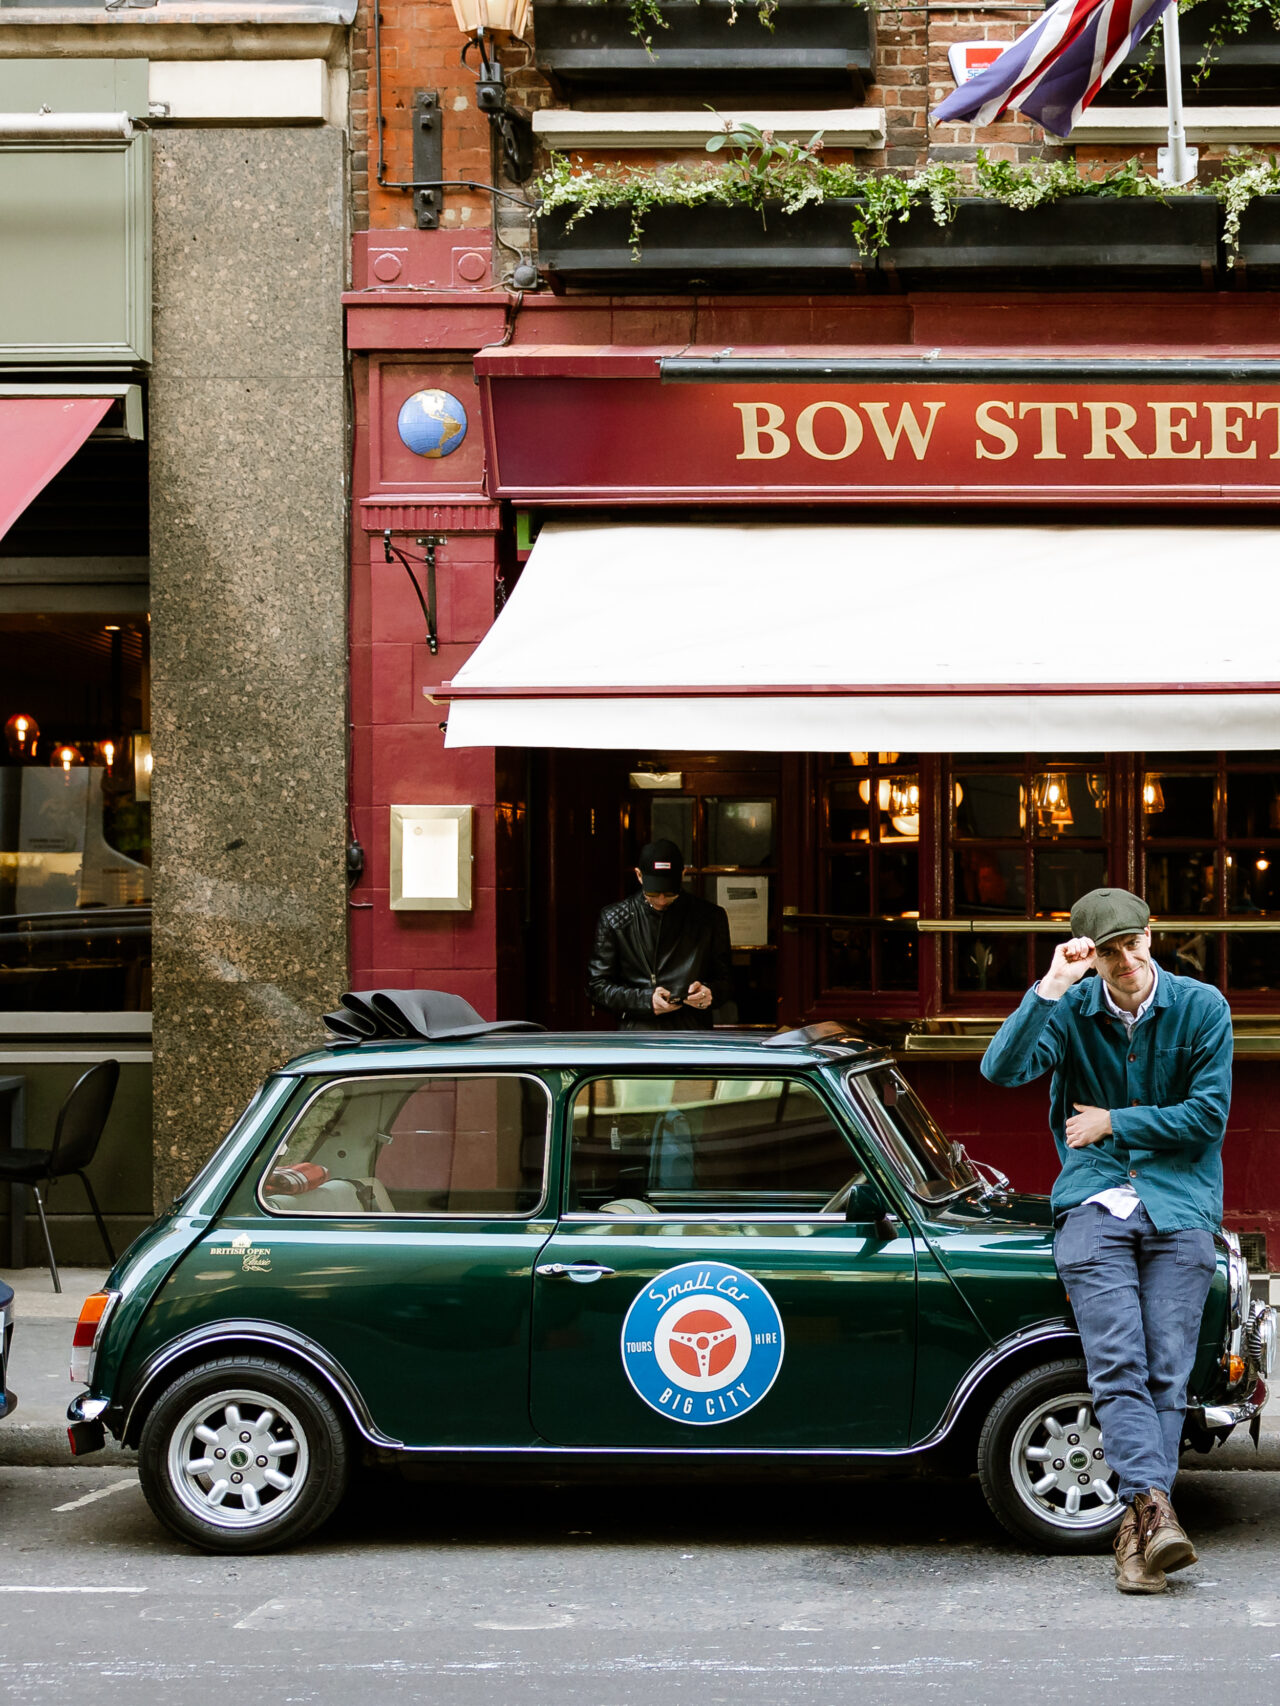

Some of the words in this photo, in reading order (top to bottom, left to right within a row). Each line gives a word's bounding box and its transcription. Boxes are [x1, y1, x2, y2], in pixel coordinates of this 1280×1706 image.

[733, 400, 946, 461] BOW
[209, 1247, 245, 1255] BRITISH
[649, 1271, 714, 1312] Small
[716, 1275, 750, 1302] Car
[626, 1341, 653, 1353] TOURS
[754, 1332, 778, 1345] HIRE
[658, 1387, 694, 1415] BIG
[705, 1382, 751, 1416] CITY
